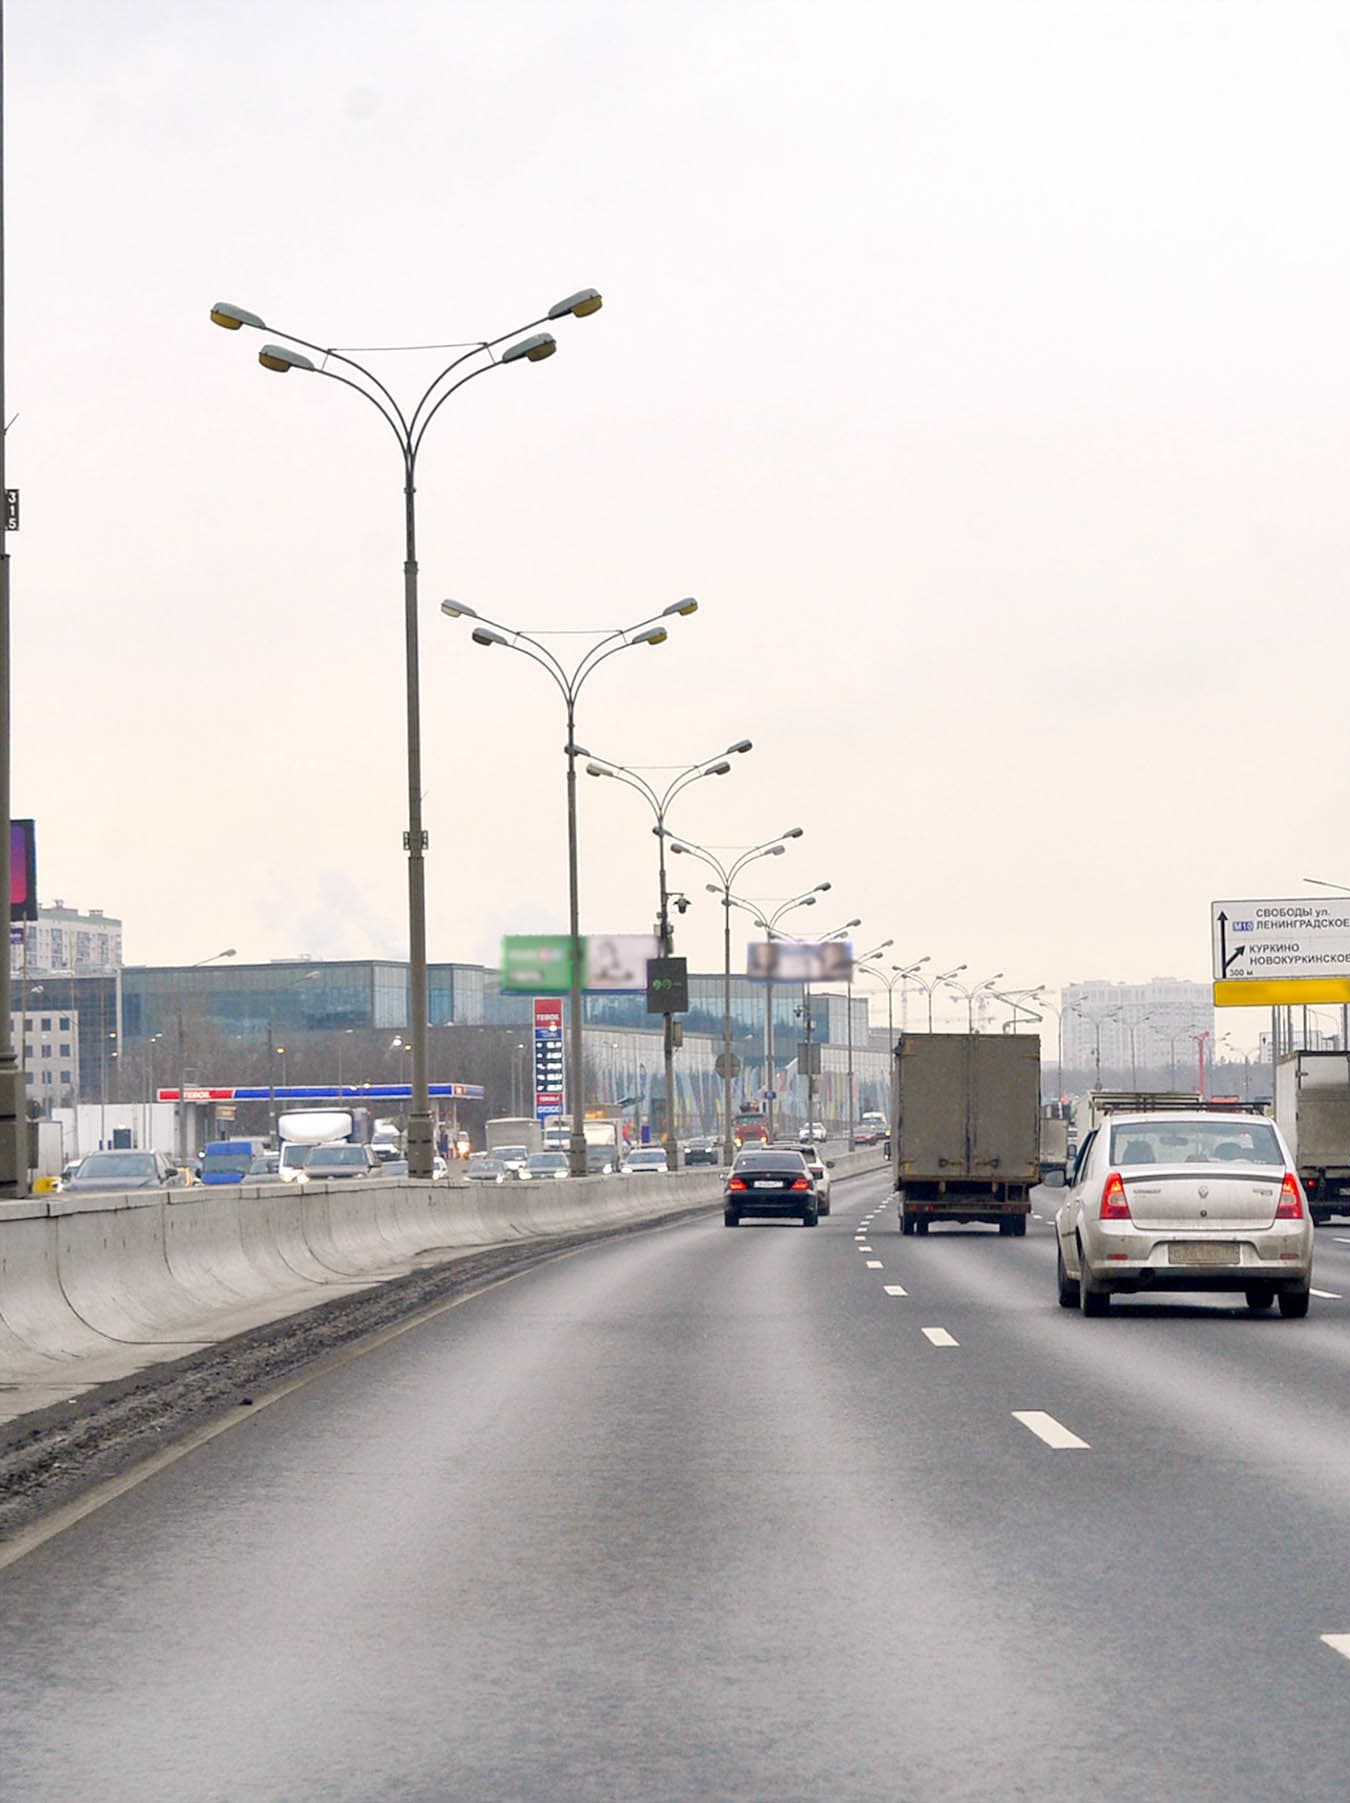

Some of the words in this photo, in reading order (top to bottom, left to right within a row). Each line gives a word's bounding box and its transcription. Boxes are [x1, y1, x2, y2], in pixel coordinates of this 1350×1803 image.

[8, 491, 17, 529] 315
[1256, 908, 1313, 918] СВОБОДЫ
[1315, 909, 1330, 918] ул.
[1256, 919, 1350, 930] ЛЕНИНГРАДСКОЕ
[1249, 943, 1299, 953] КУРКИНО
